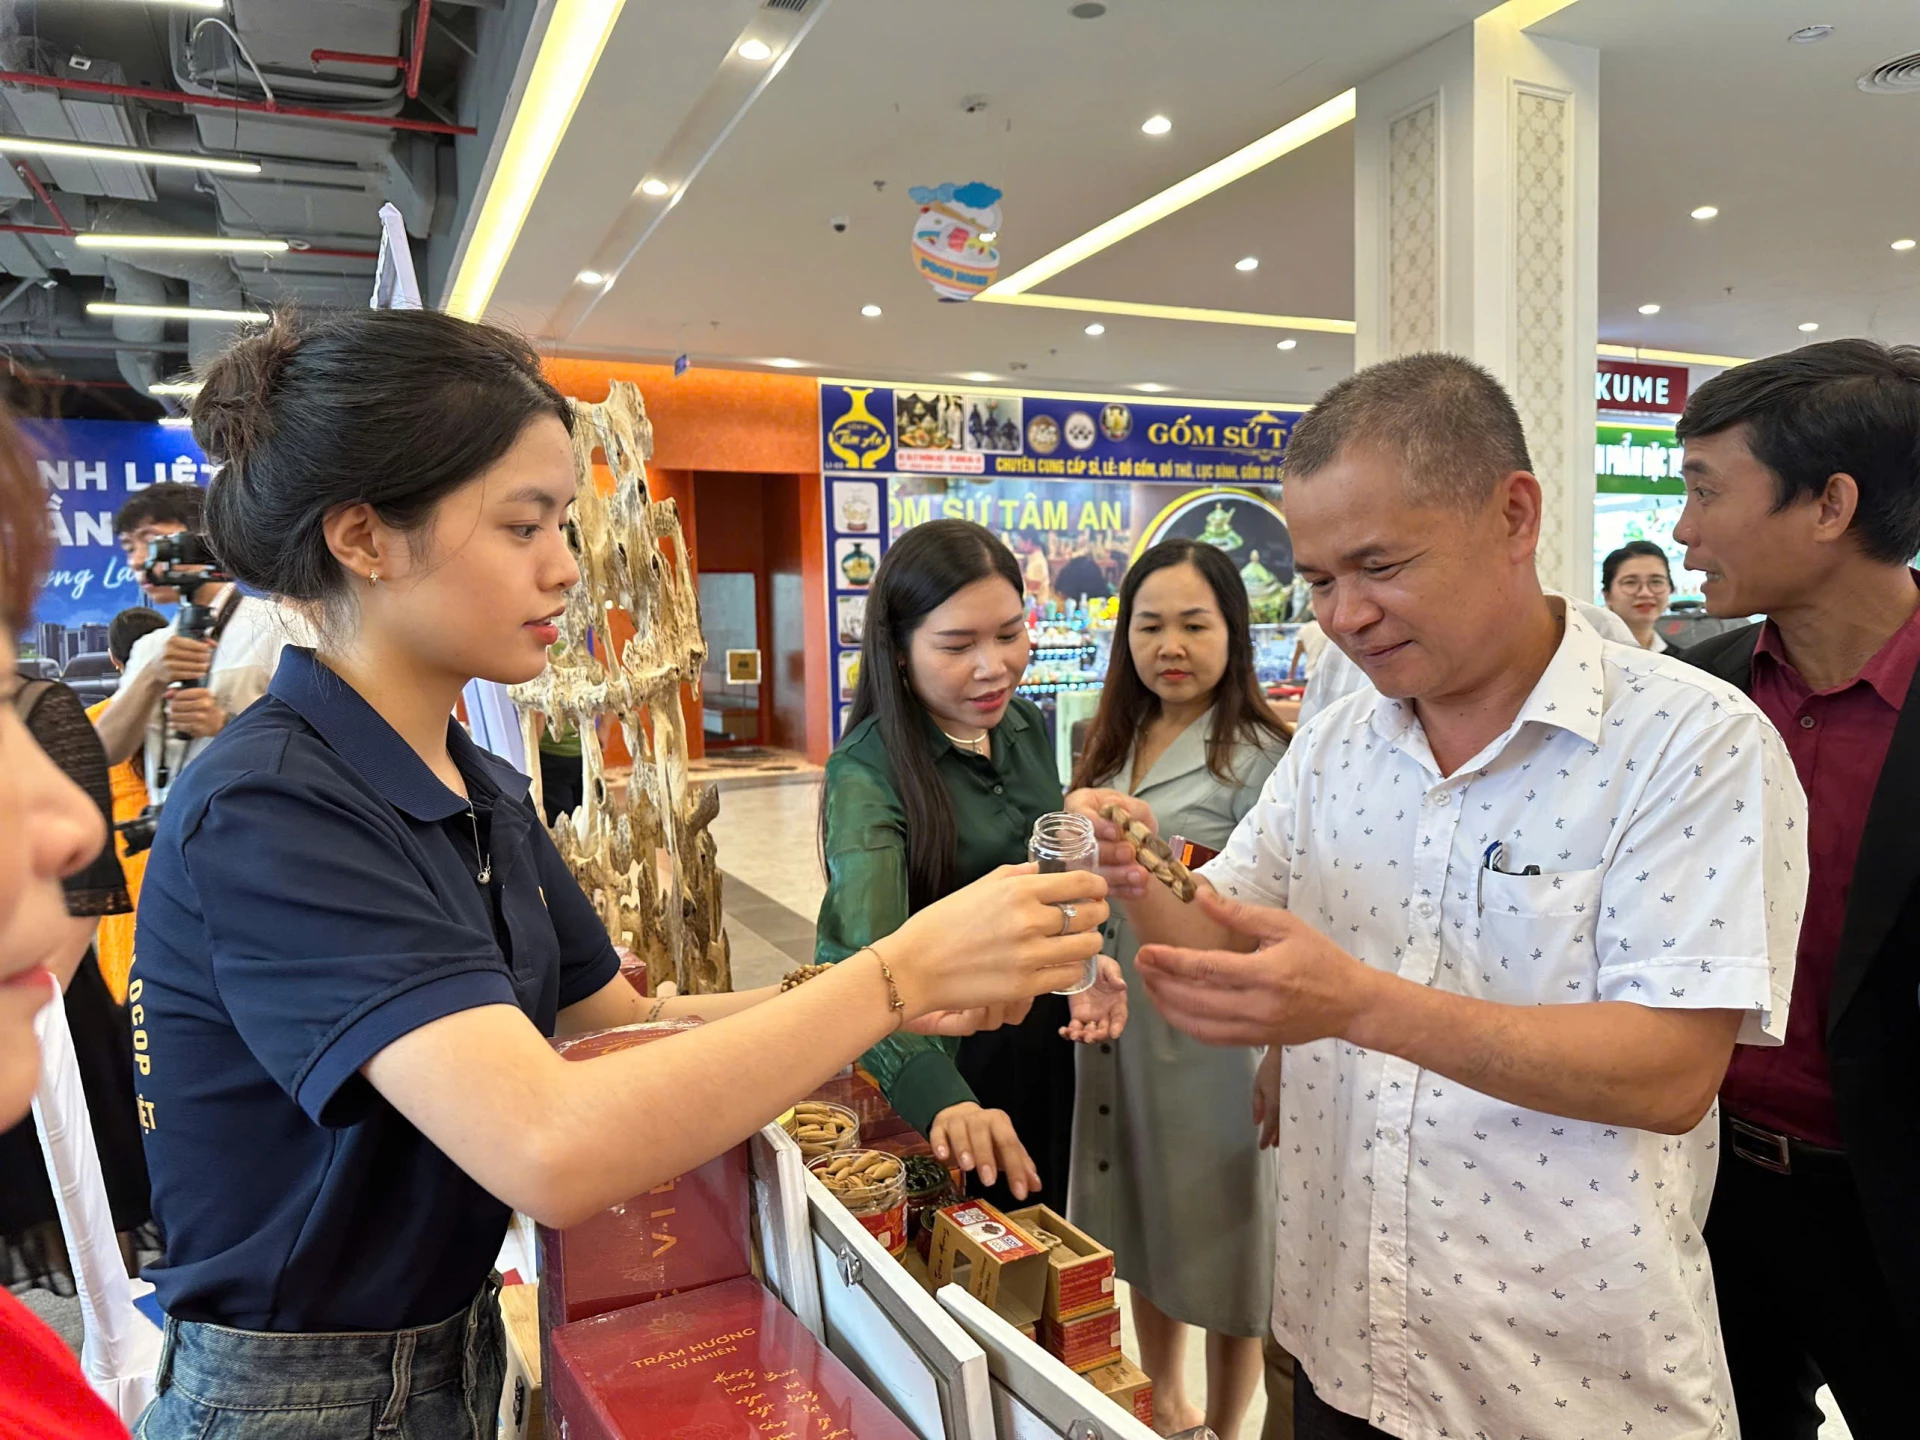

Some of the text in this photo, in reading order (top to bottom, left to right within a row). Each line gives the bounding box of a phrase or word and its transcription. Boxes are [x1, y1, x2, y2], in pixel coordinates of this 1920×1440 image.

[1147, 414, 1216, 445] GỐM
[1222, 421, 1262, 448] SỨ
[998, 492, 1068, 530] TÂM
[1077, 500, 1121, 530] AN
[689, 1328, 756, 1353] HƯƠNG
[691, 1345, 738, 1364] NHIÊN
